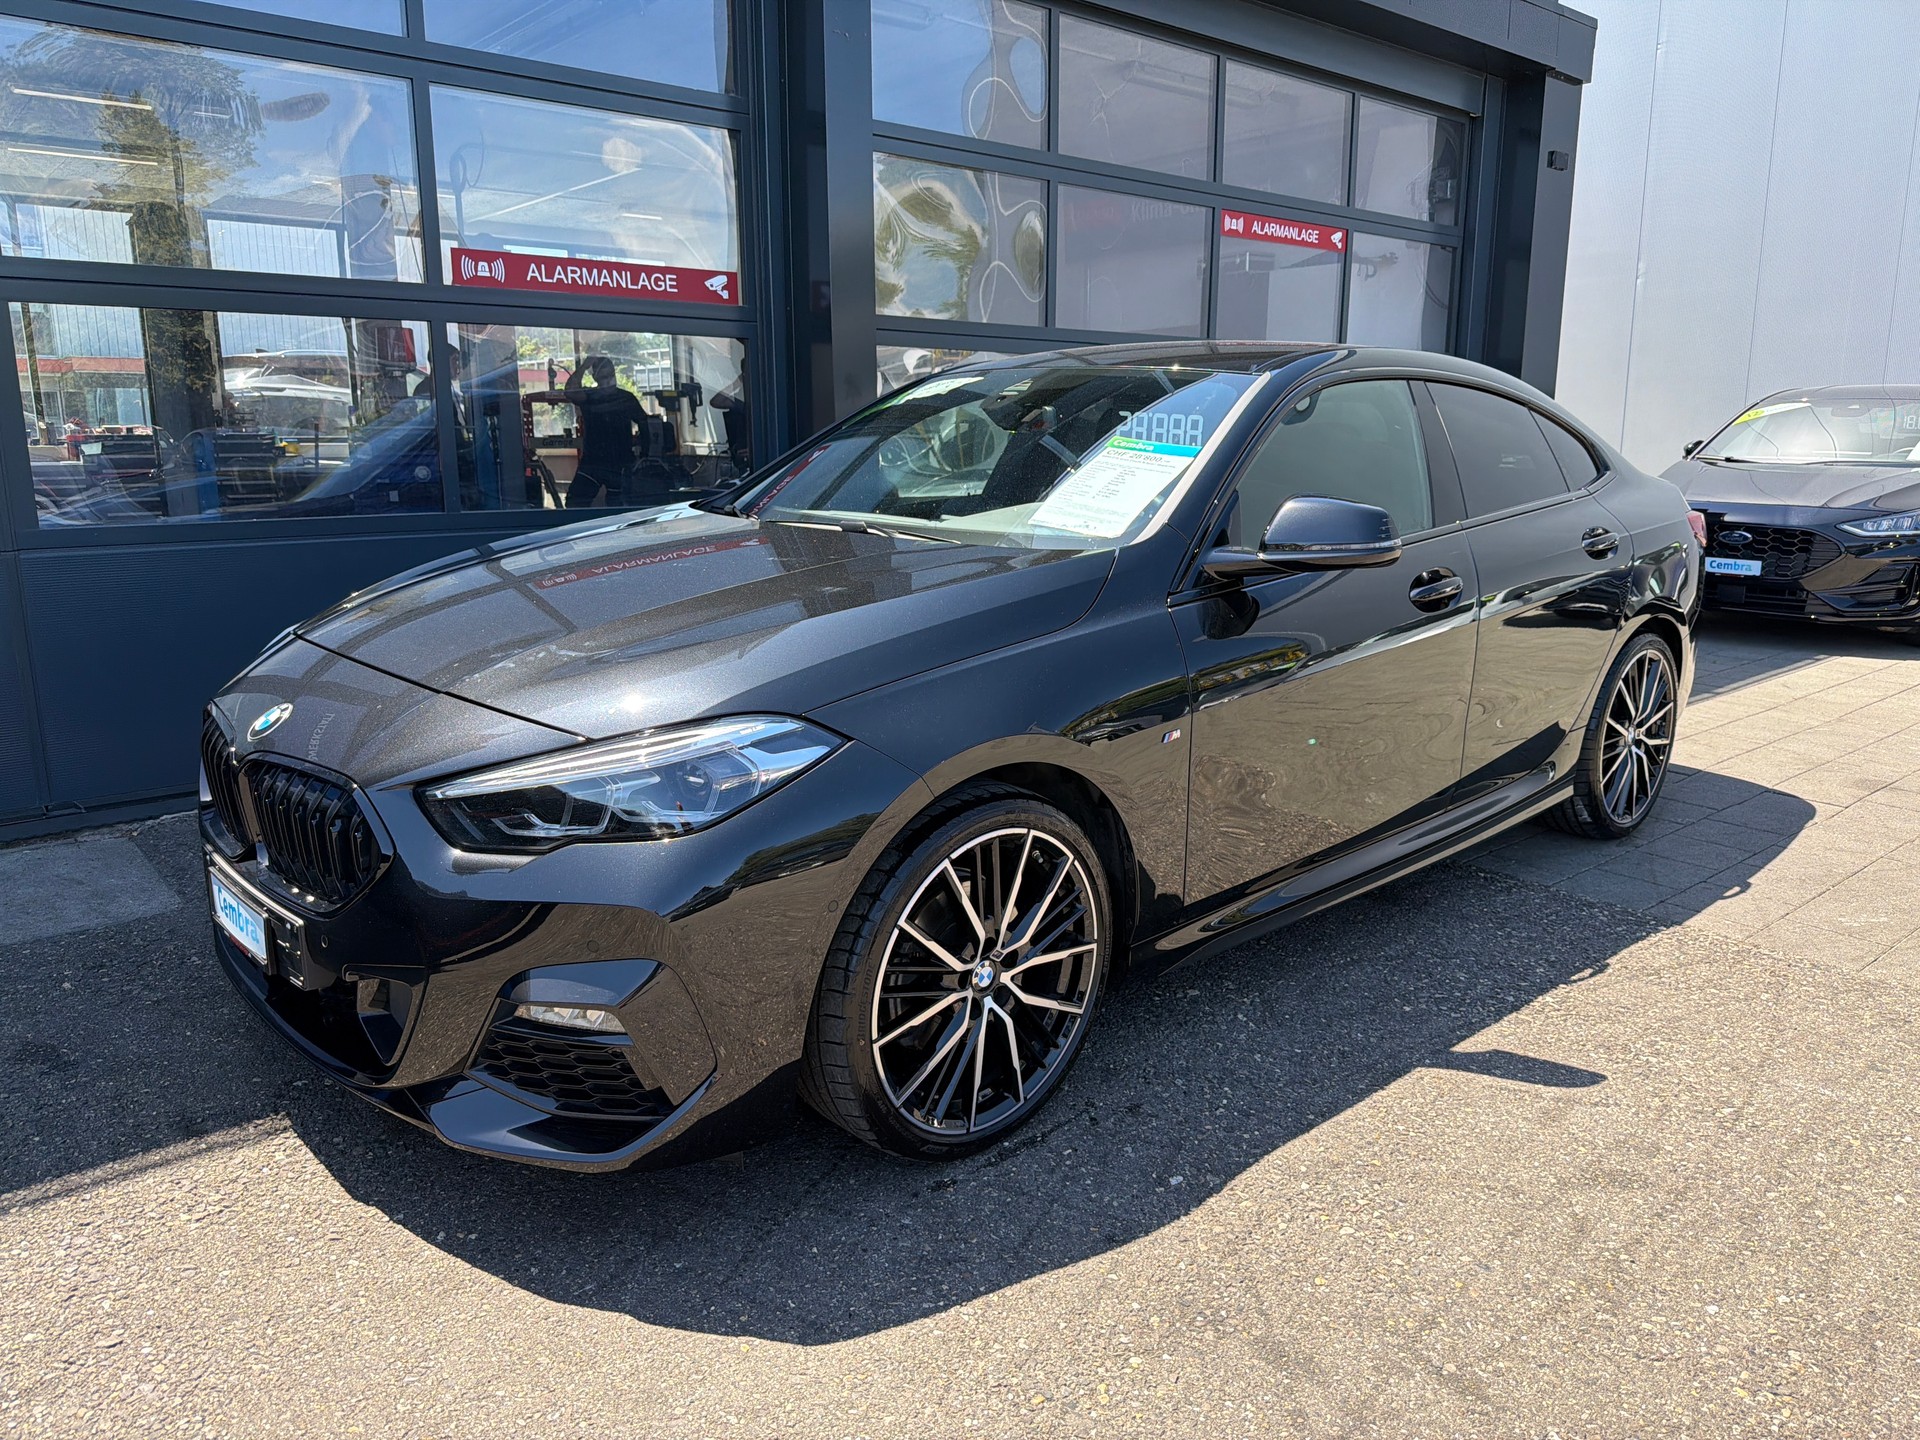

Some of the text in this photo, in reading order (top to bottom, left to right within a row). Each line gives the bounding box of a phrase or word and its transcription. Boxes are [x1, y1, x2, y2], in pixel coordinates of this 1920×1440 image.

[1251, 220, 1320, 243] ALARMANLAGE
[526, 263, 679, 293] ALARMANLAGE
[1113, 439, 1155, 452] Cembra
[1709, 560, 1752, 572] Cembra
[217, 885, 260, 945] Cembra
